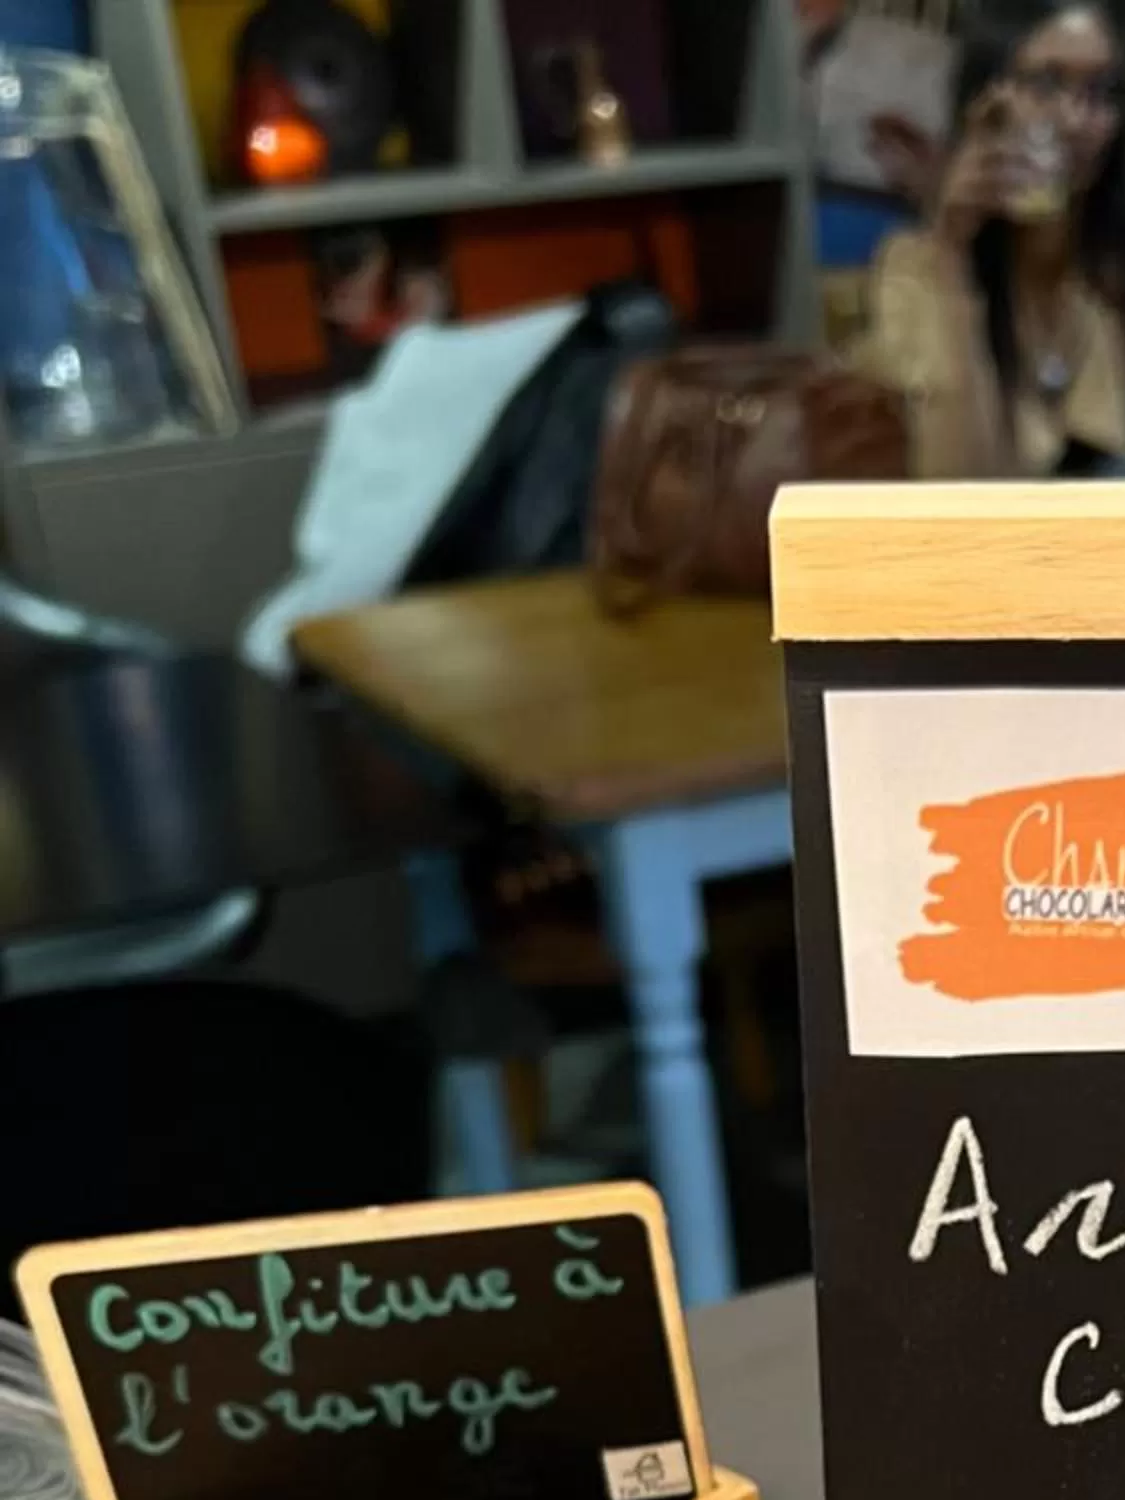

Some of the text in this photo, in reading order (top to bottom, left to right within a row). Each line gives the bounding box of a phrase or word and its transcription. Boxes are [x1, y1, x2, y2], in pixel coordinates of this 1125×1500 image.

[89, 1226, 624, 1375] Confiture à
[117, 1364, 557, 1455] l'orange
